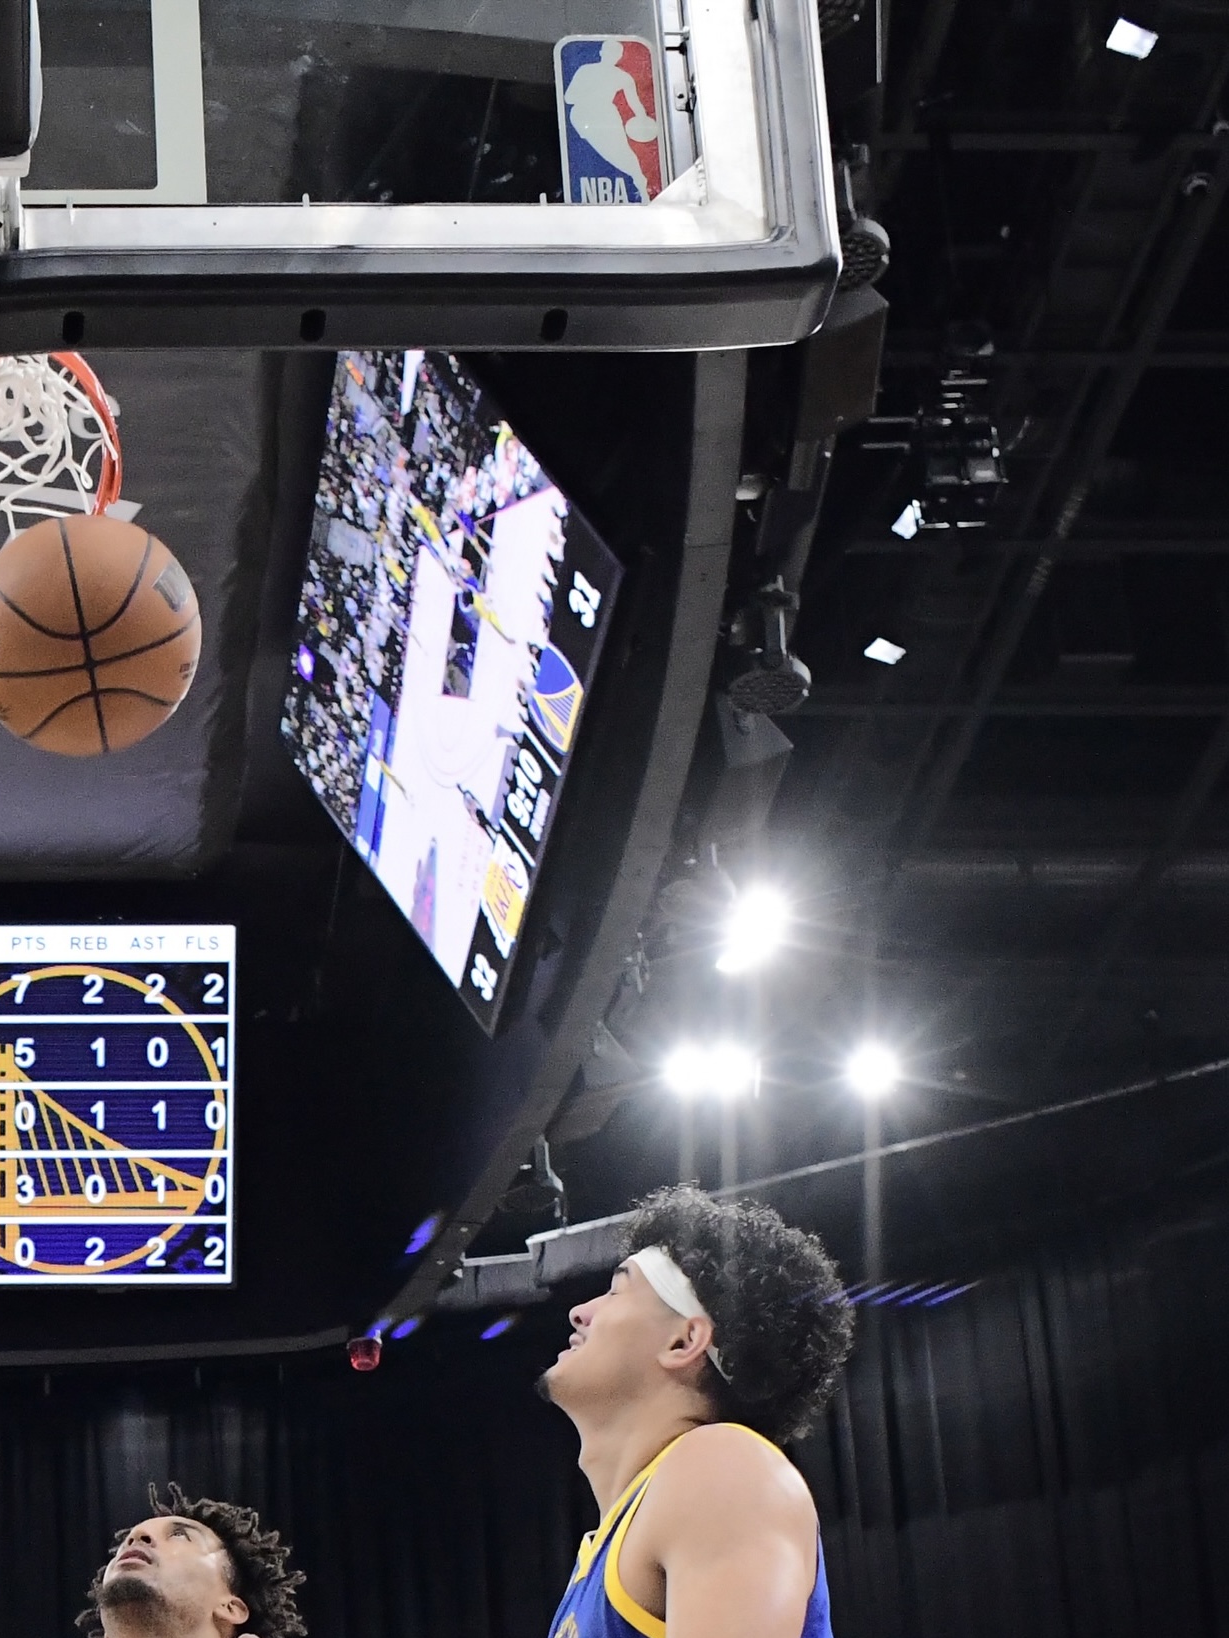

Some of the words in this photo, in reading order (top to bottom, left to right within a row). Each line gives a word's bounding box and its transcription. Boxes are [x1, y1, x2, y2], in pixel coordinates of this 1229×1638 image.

[579, 176, 629, 204] NBA
[11, 936, 46, 950] PTS
[71, 936, 108, 950] REB
[130, 936, 165, 950] AST
[186, 936, 219, 950] FLS
[11, 974, 32, 1004] 7
[82, 974, 104, 1004] 2
[144, 973, 166, 1004] 2
[203, 973, 225, 1004] 2
[14, 1037, 36, 1068] 5
[90, 1037, 106, 1068] 1
[147, 1037, 169, 1068] 0
[211, 1037, 226, 1068] 1
[15, 1101, 36, 1131] 0
[90, 1101, 106, 1131] 1
[151, 1101, 167, 1130] 1
[204, 1101, 226, 1131] 0
[15, 1175, 36, 1205] 3
[84, 1174, 106, 1205] 0
[151, 1174, 166, 1204] 1
[204, 1174, 225, 1204] 0
[14, 1237, 36, 1268] 0
[84, 1237, 106, 1267] 2
[145, 1237, 167, 1267] 2
[203, 1237, 225, 1267] 2
